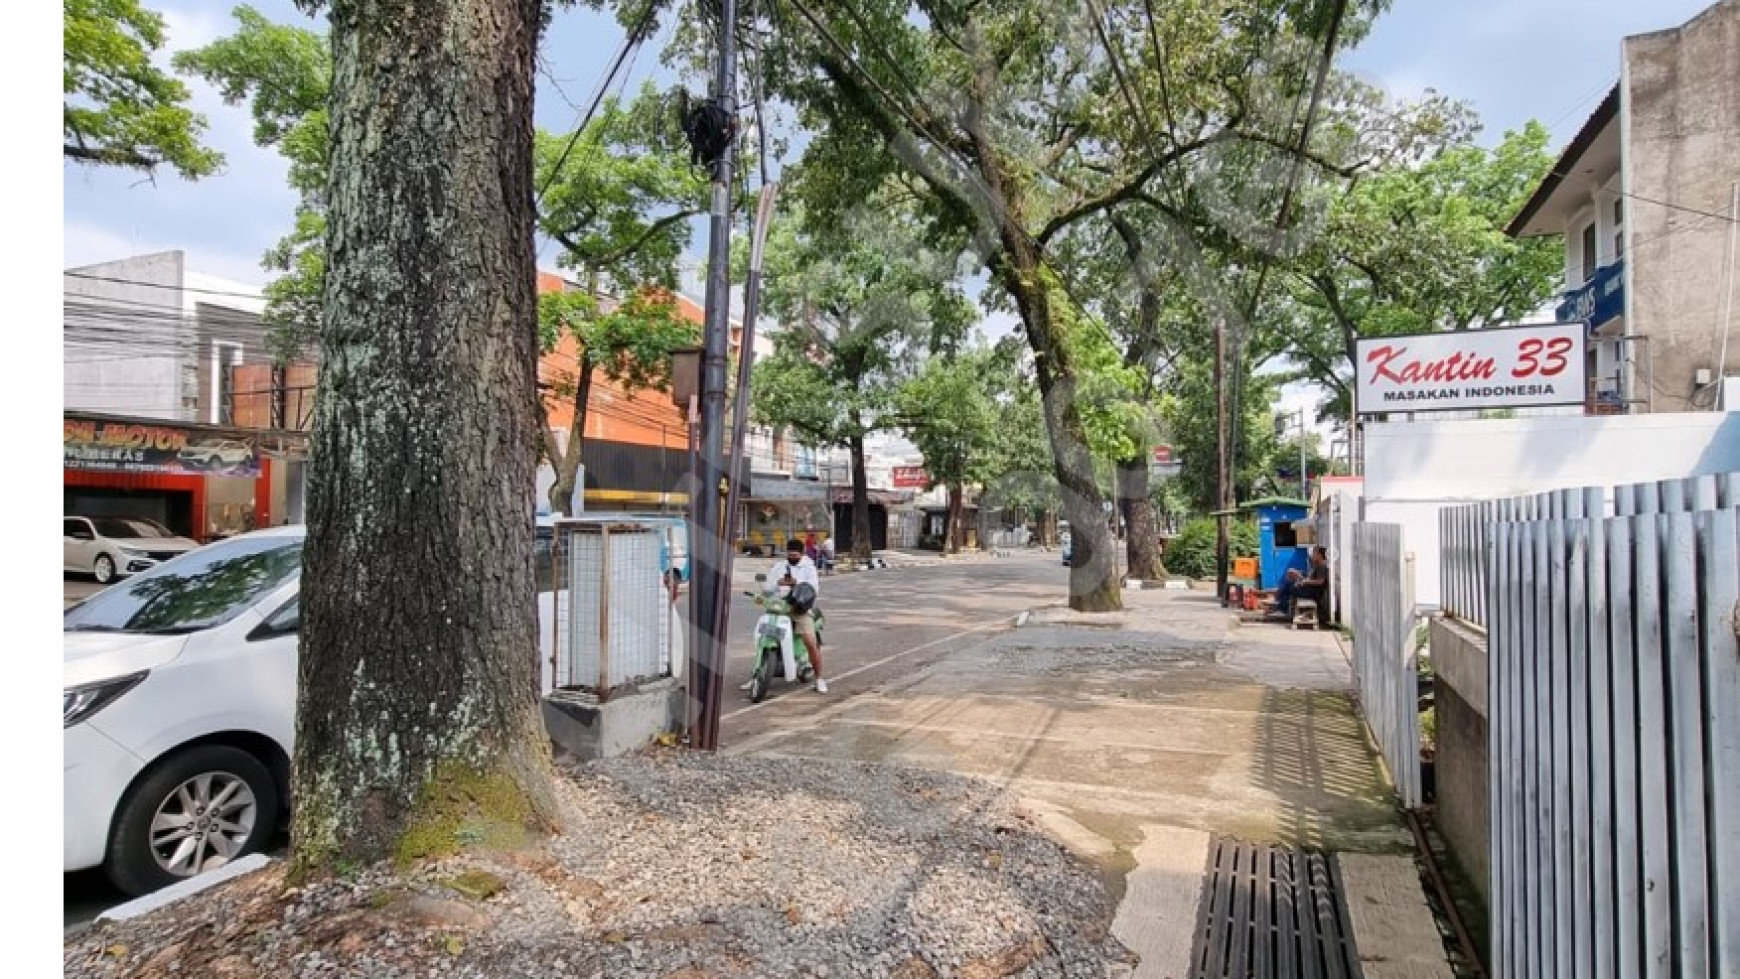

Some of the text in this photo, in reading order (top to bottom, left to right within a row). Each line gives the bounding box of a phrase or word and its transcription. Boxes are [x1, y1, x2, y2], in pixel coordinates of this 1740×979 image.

[1366, 337, 1573, 385] Kantin 33
[1384, 384, 1555, 402] MASAKAN INDONESIA
